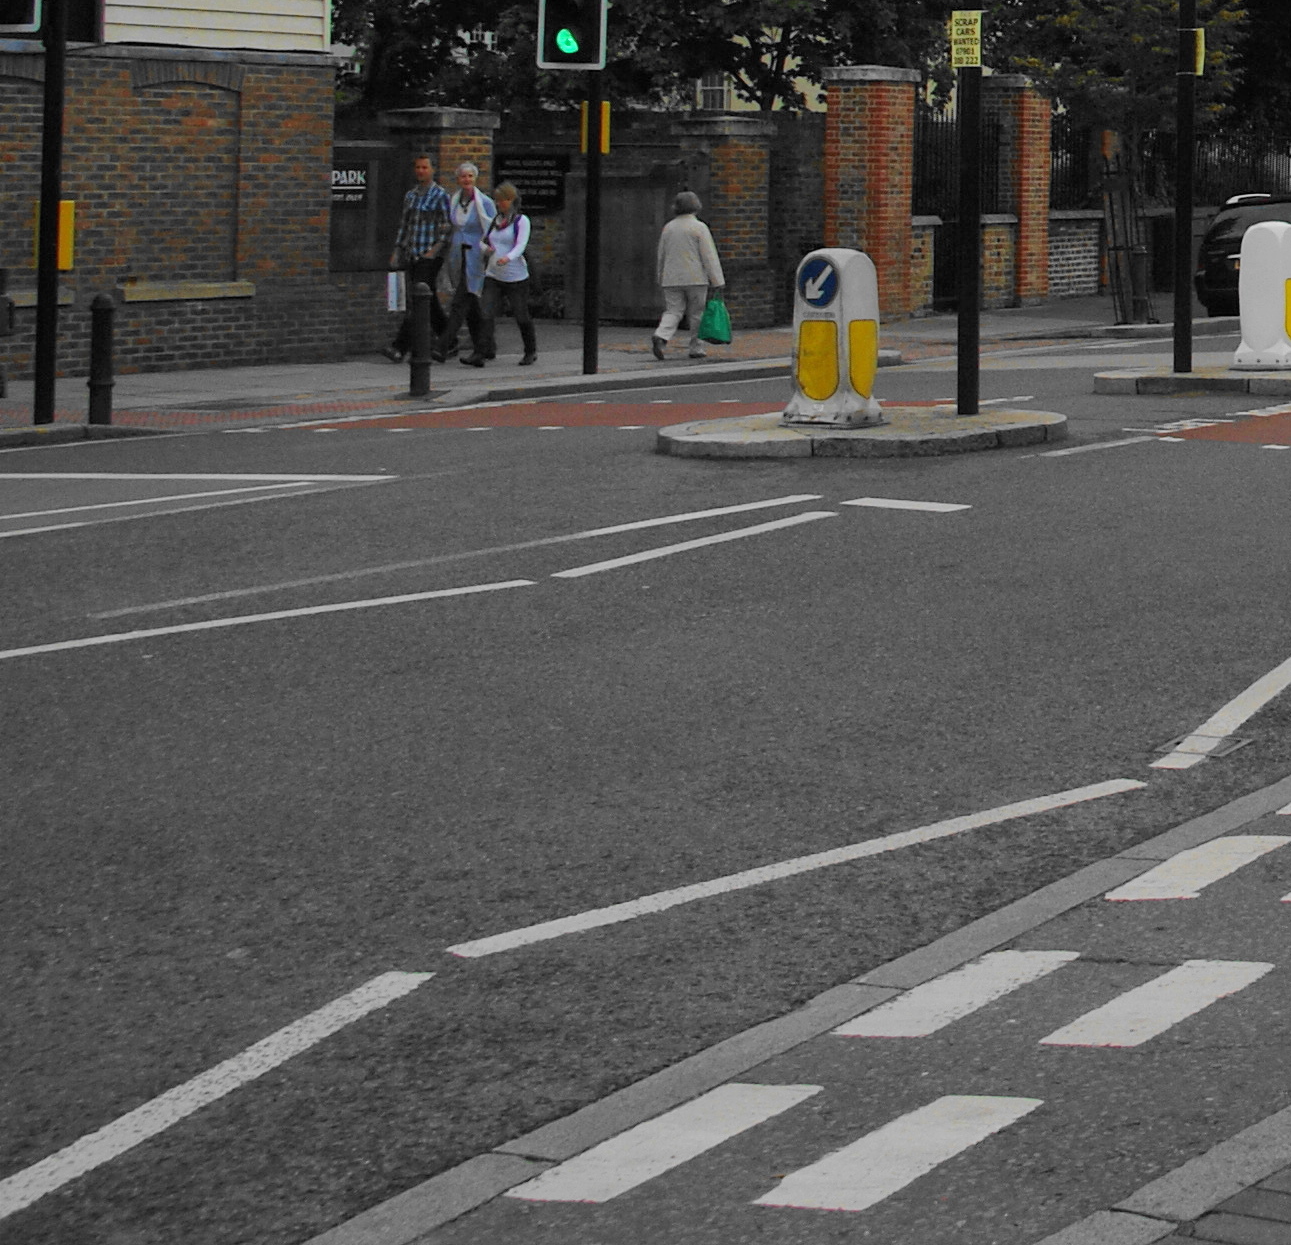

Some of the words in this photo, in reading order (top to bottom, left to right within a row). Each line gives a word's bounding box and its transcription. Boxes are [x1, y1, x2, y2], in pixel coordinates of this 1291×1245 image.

[954, 18, 979, 27] SCRAP
[955, 27, 976, 36] CARS
[331, 170, 366, 185] PARK
